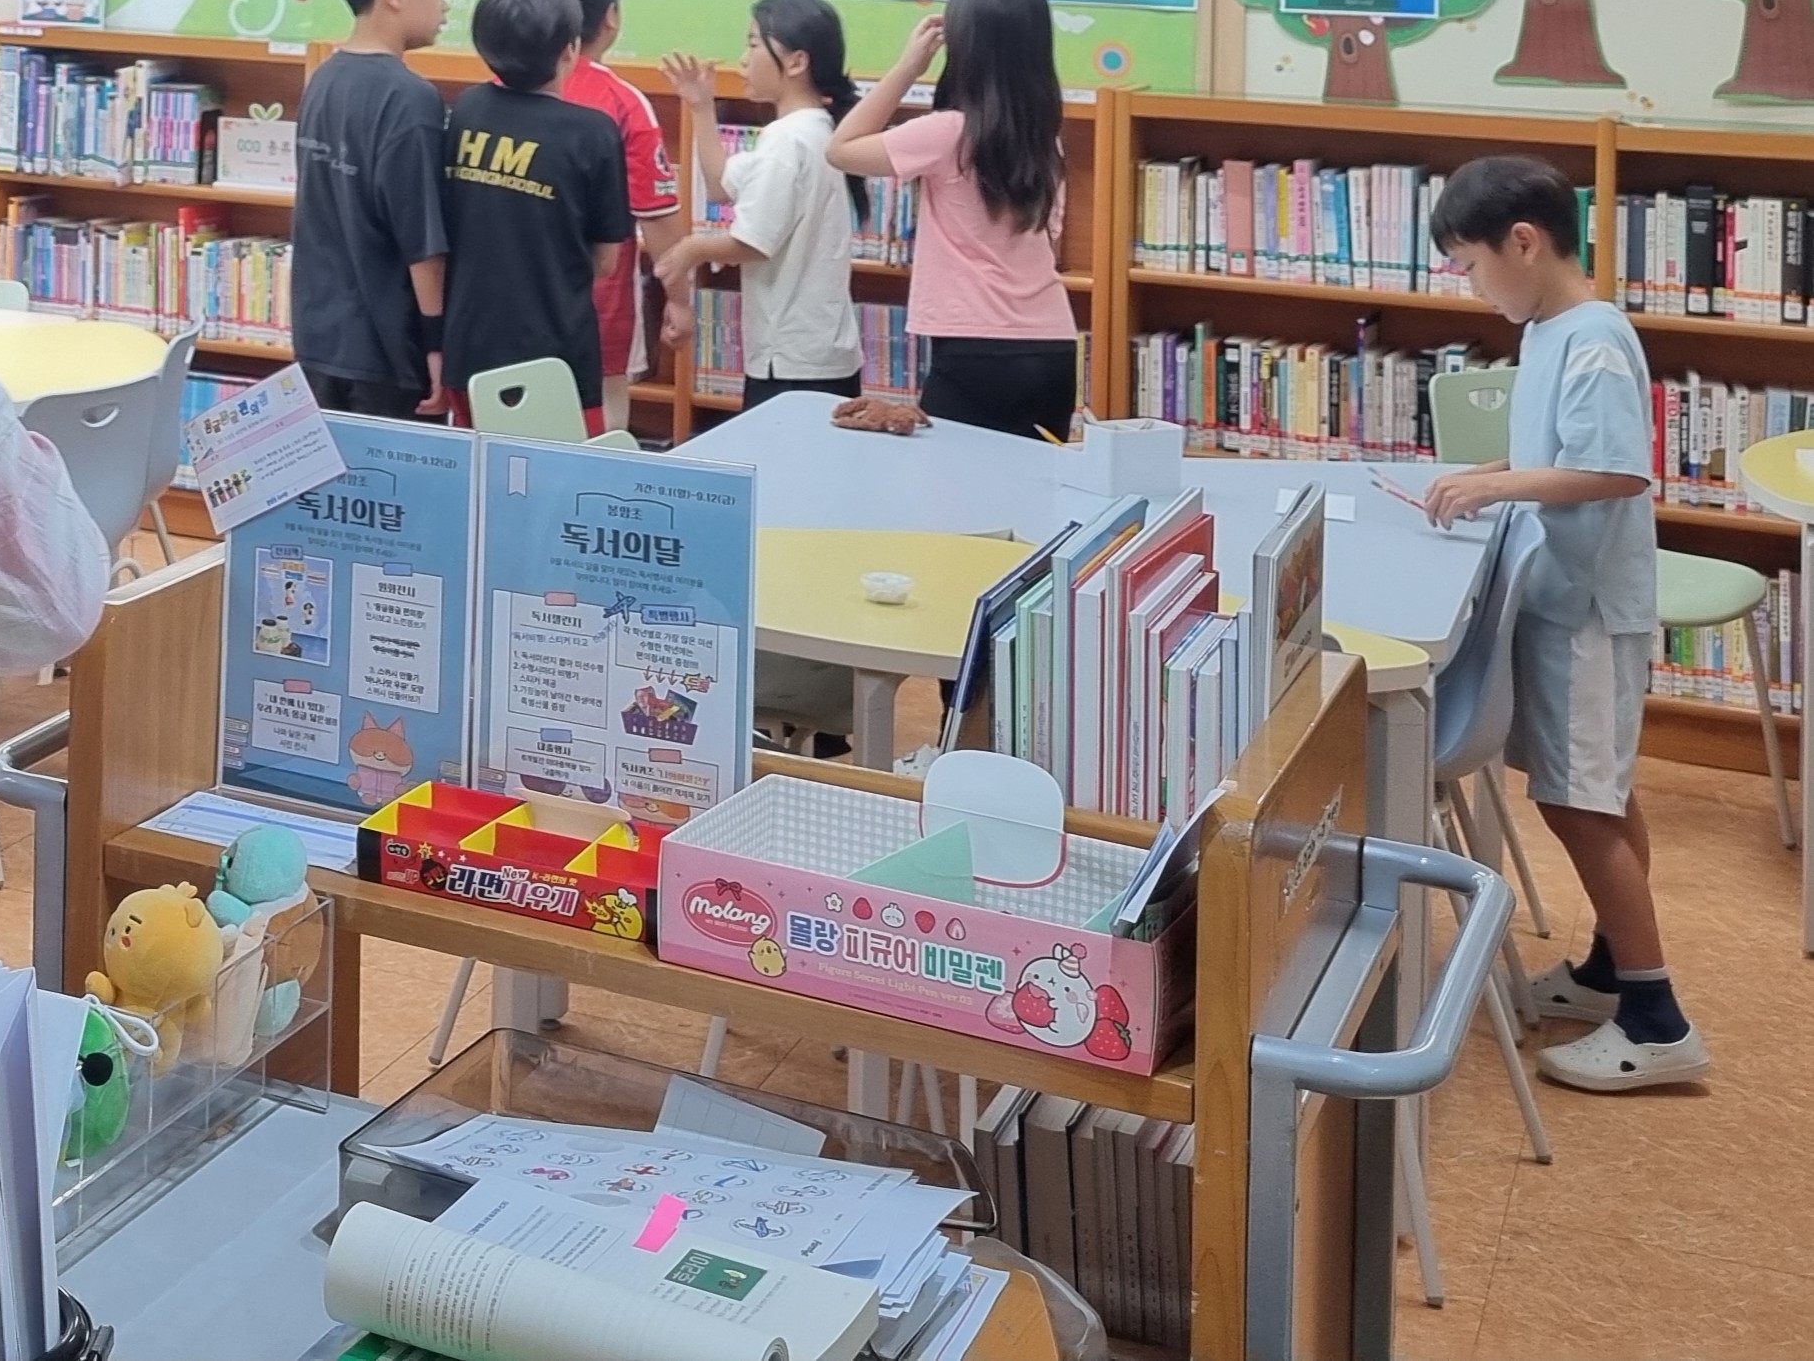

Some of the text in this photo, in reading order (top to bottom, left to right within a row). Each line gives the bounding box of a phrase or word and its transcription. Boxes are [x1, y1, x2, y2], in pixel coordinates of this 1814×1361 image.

[634, 482, 656, 495] 기간:
[295, 490, 406, 533] 독서의달
[606, 504, 644, 521] 봉암초
[559, 522, 686, 568] 독서의달
[377, 582, 416, 598] 원화전시
[531, 610, 582, 629] 독서챌린지
[697, 638, 714, 649] 미션
[557, 669, 580, 681] 비행기
[574, 660, 604, 674] 미션수행
[519, 674, 541, 685] 스티커
[536, 741, 572, 757] 대출행사
[621, 761, 656, 778] 독서퀴즈
[500, 865, 529, 881] New
[445, 864, 581, 917] 라면지우개
[689, 895, 771, 936] molang
[788, 912, 1004, 993] 몰랑 피규어 비밀펜
[817, 961, 853, 979] Figure
[853, 969, 886, 985] Secret
[887, 976, 917, 993] Light
[917, 983, 938, 997] Pen
